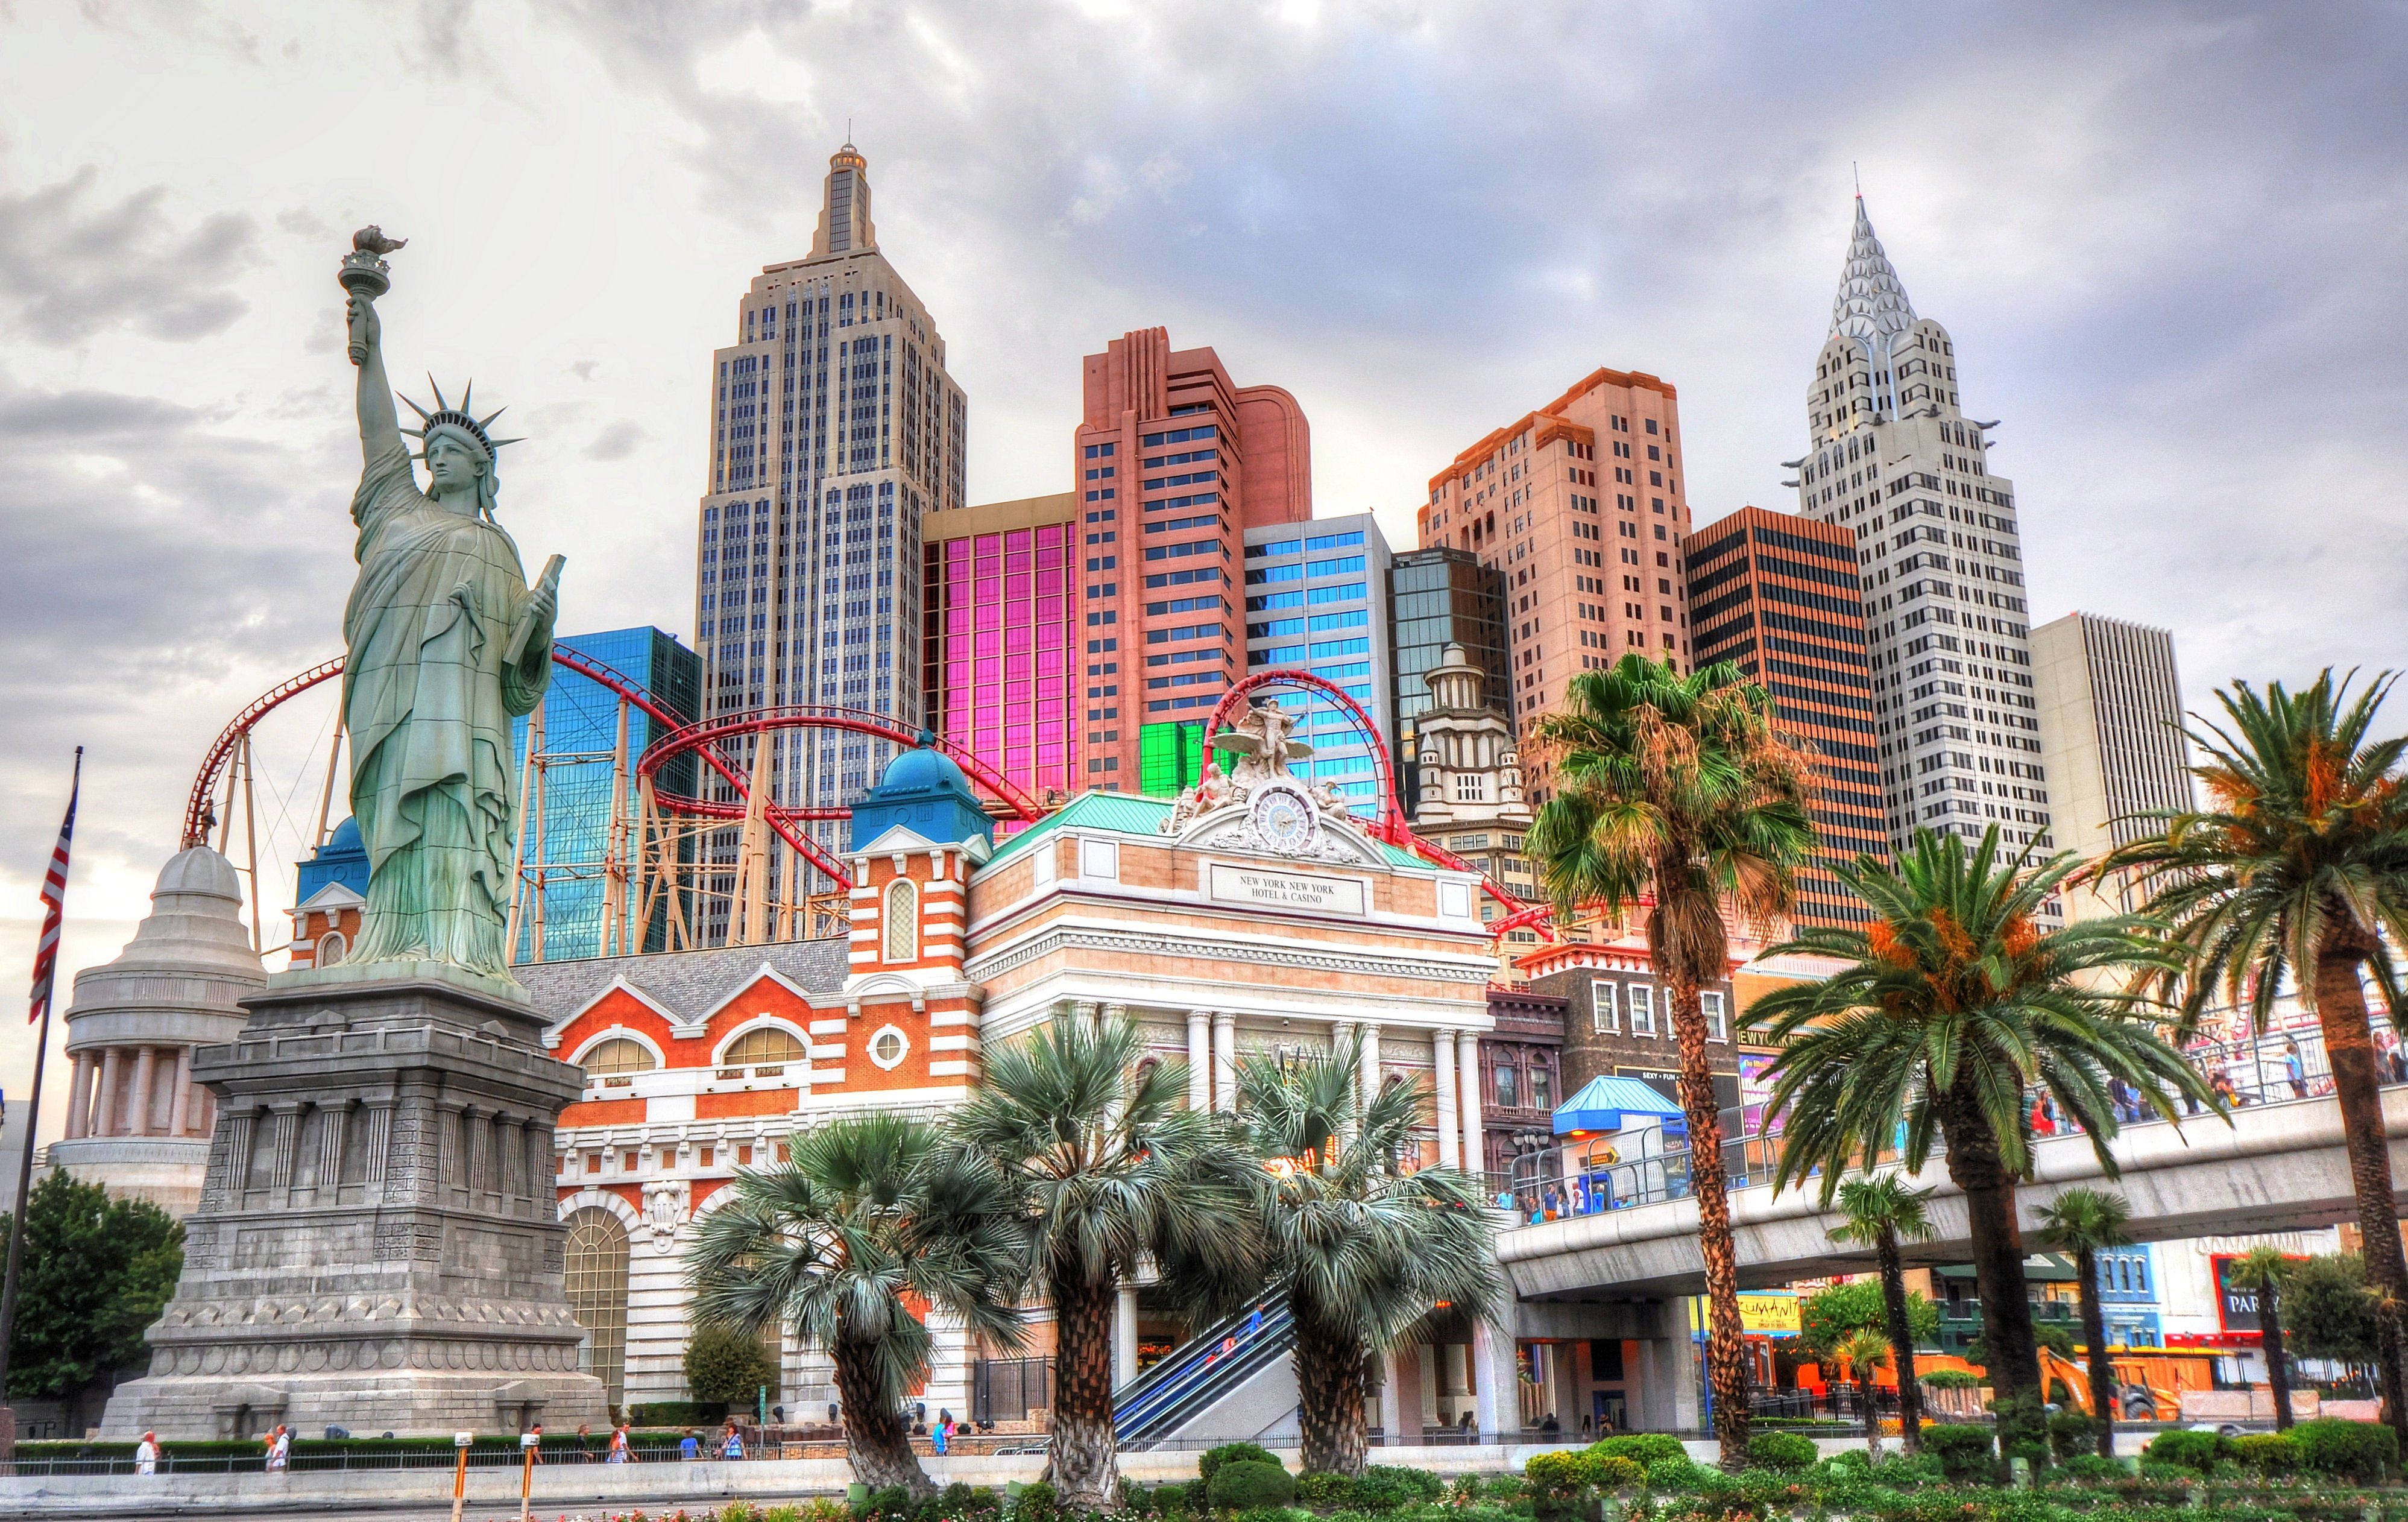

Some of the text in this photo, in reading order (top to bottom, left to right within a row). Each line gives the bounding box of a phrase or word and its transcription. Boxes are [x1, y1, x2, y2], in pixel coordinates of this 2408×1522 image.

[1240, 876, 1334, 894] NEW YORK NEW YORK
[1252, 888, 1279, 899] HOTEL
[1291, 892, 1322, 903] CASINO
[2228, 1295, 2279, 1313] PARY
